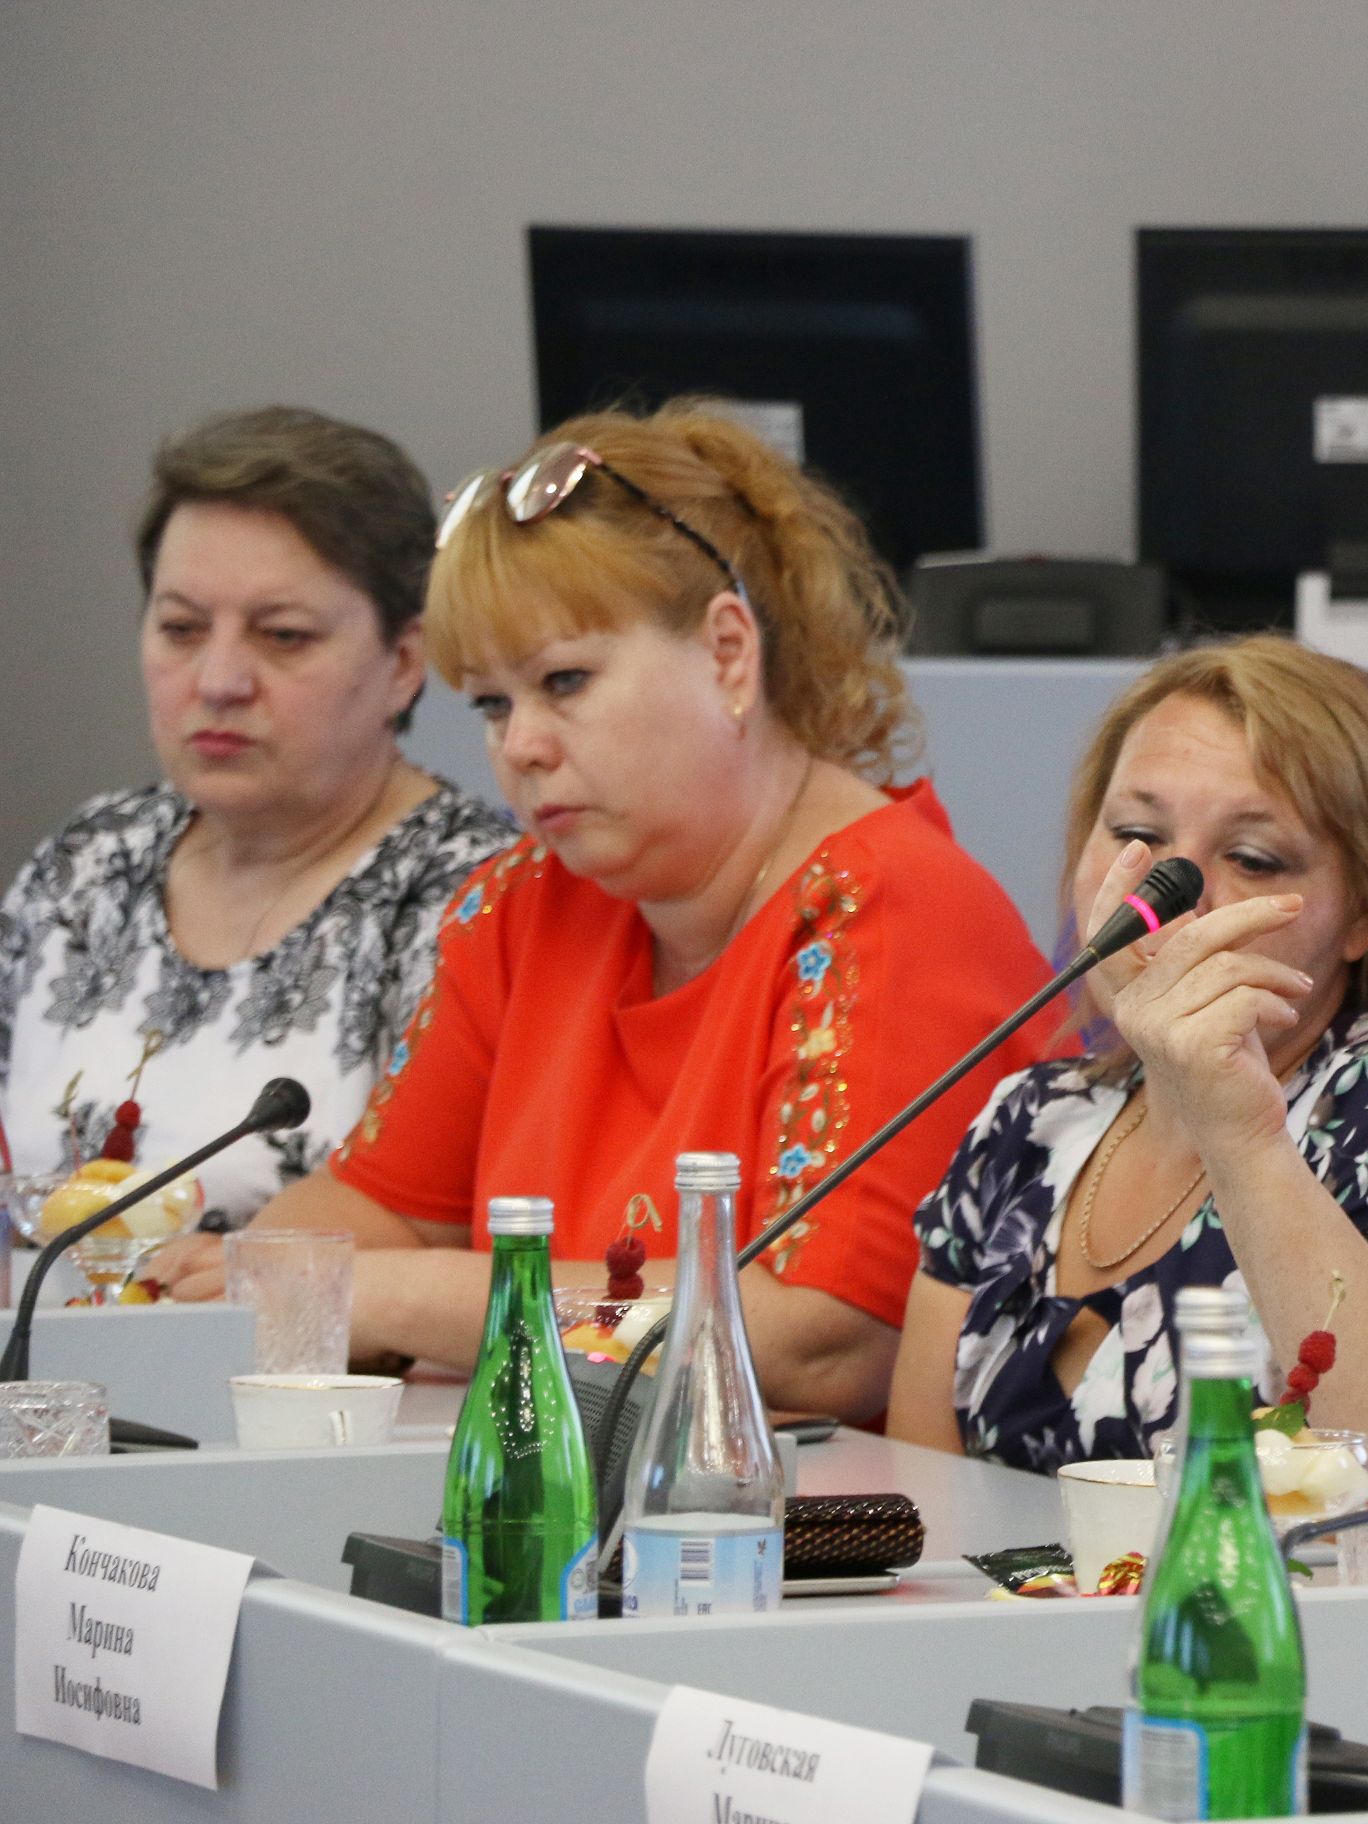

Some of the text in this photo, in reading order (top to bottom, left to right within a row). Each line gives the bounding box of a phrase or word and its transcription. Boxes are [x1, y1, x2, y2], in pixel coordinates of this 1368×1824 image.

[64, 1534, 161, 1592] Кончакова
[66, 1602, 134, 1659] Марина
[54, 1665, 142, 1725] Иосифовна
